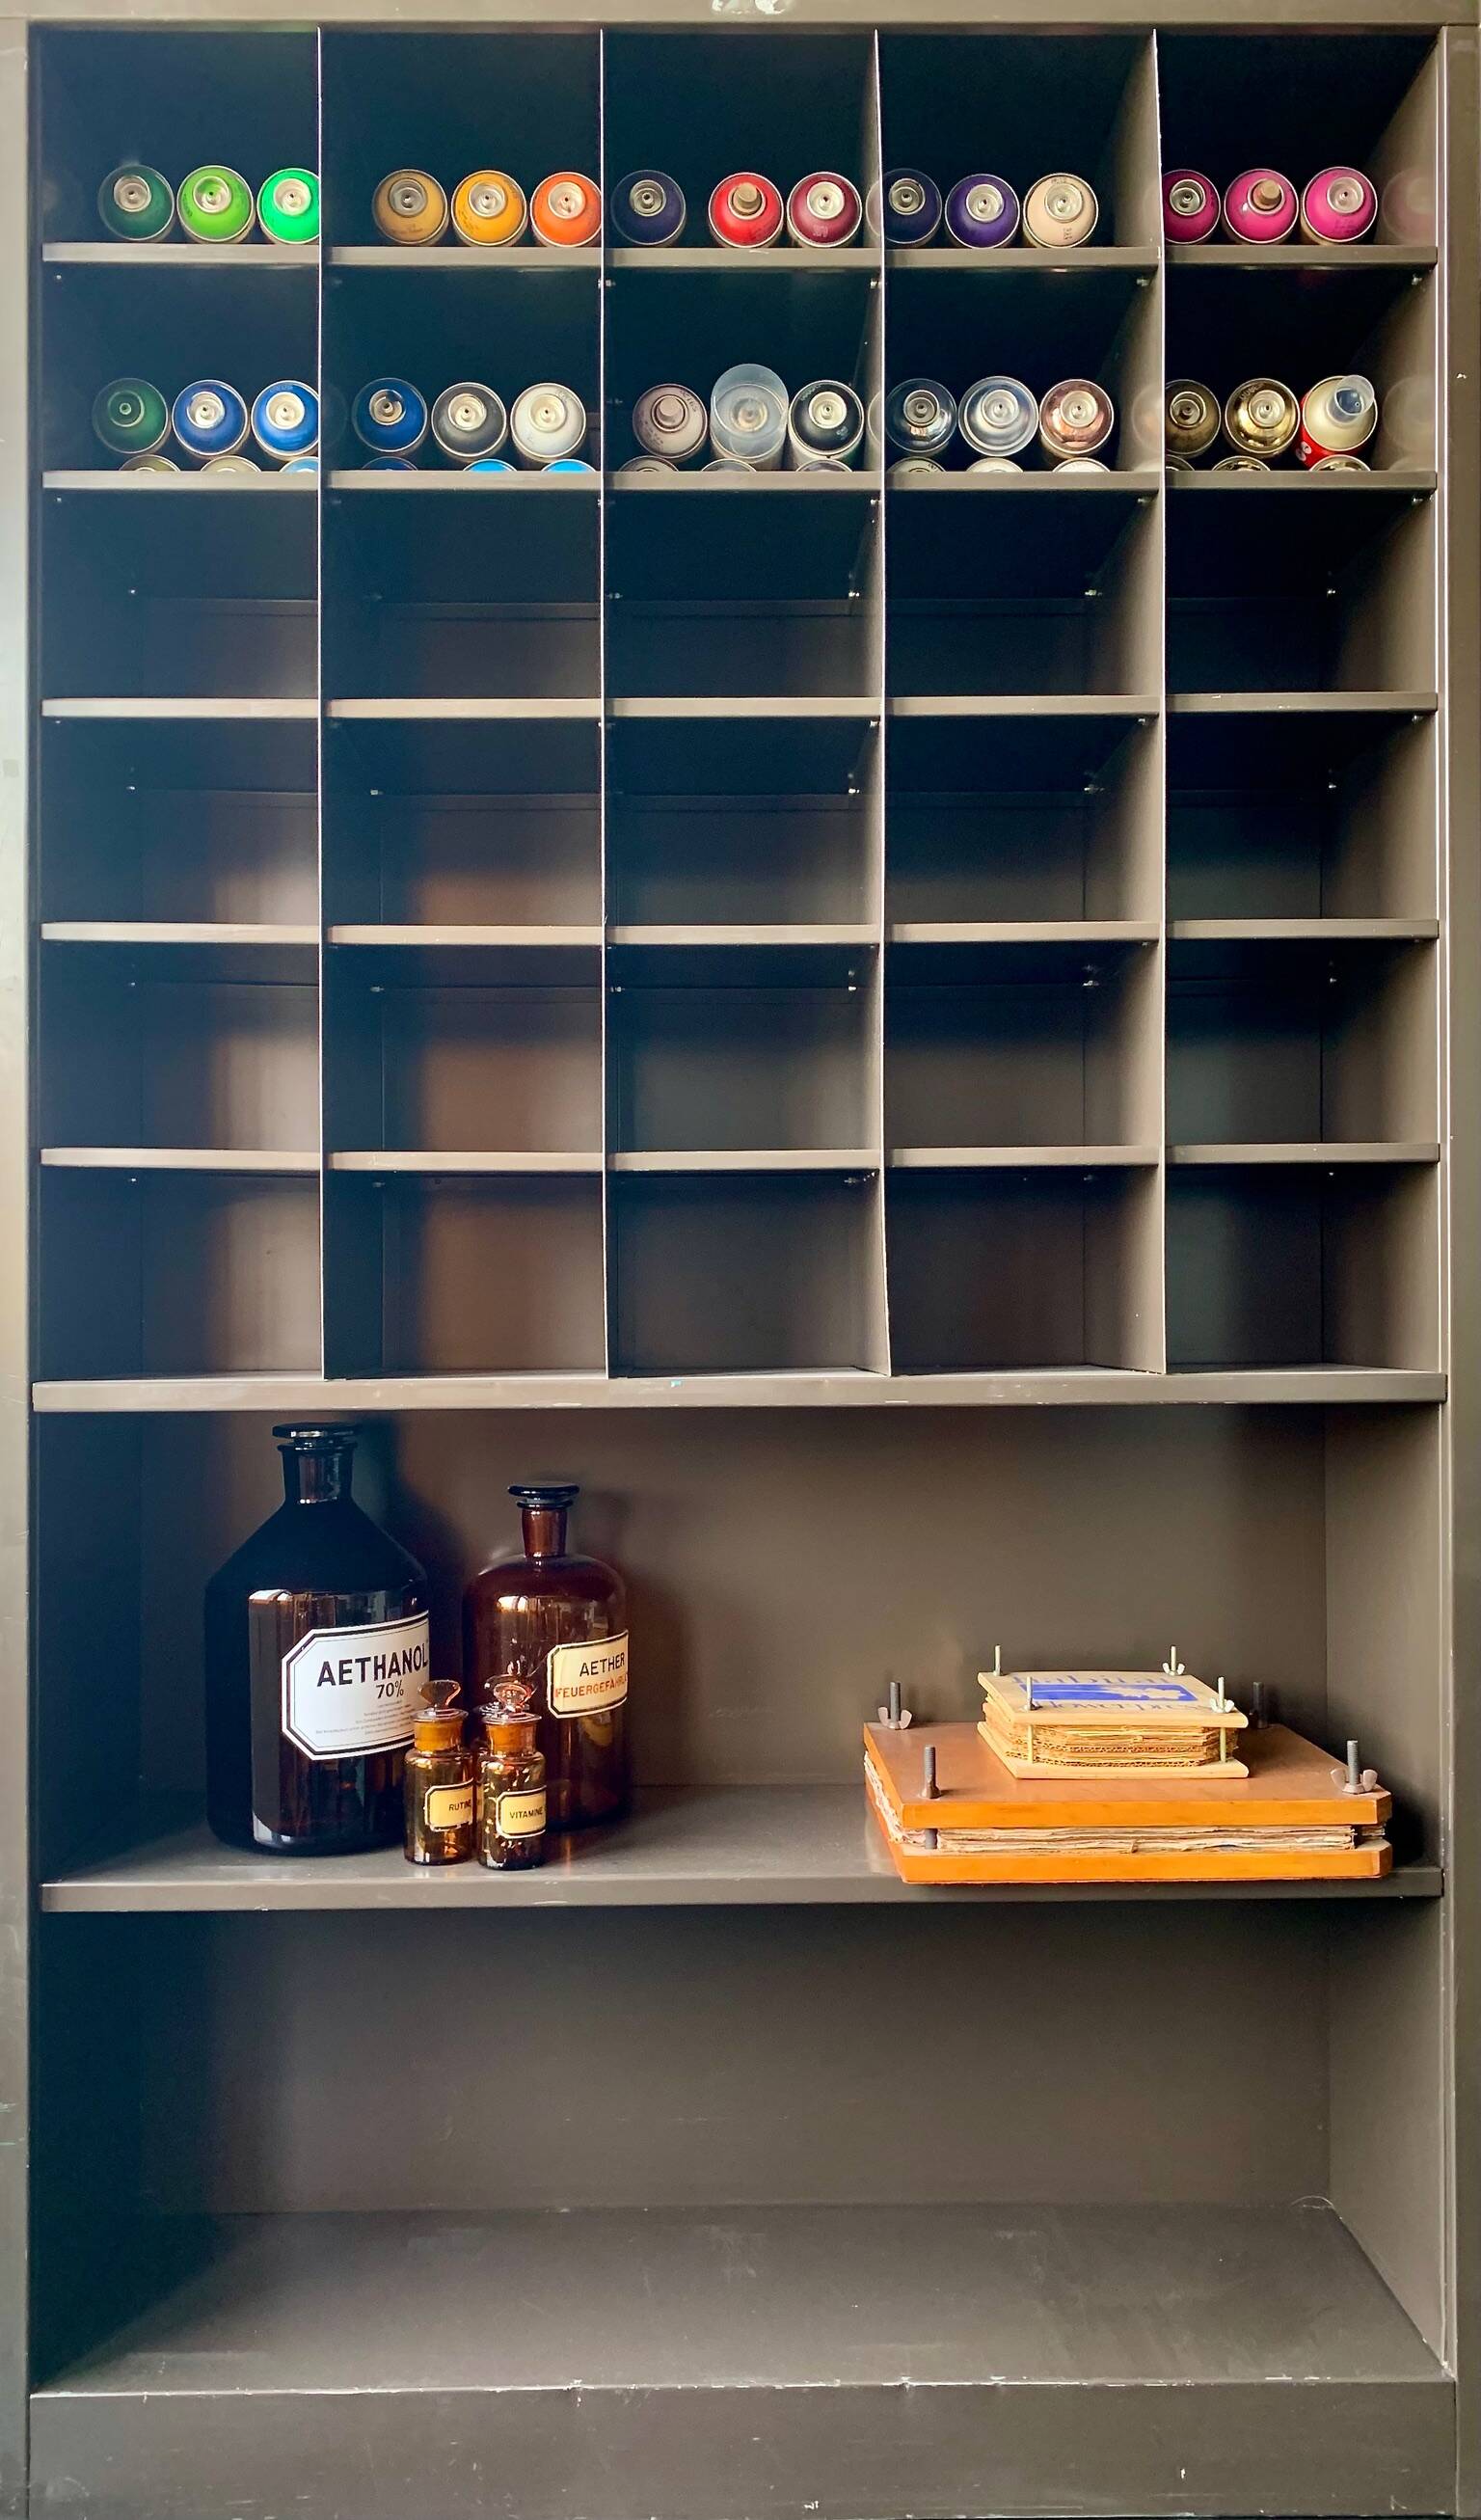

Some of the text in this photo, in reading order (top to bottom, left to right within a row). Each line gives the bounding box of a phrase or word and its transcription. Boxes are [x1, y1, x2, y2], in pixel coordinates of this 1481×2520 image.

[316, 1642, 429, 1688] AETHANOL
[579, 1651, 626, 1677] AETHER
[375, 1679, 405, 1699] 70%
